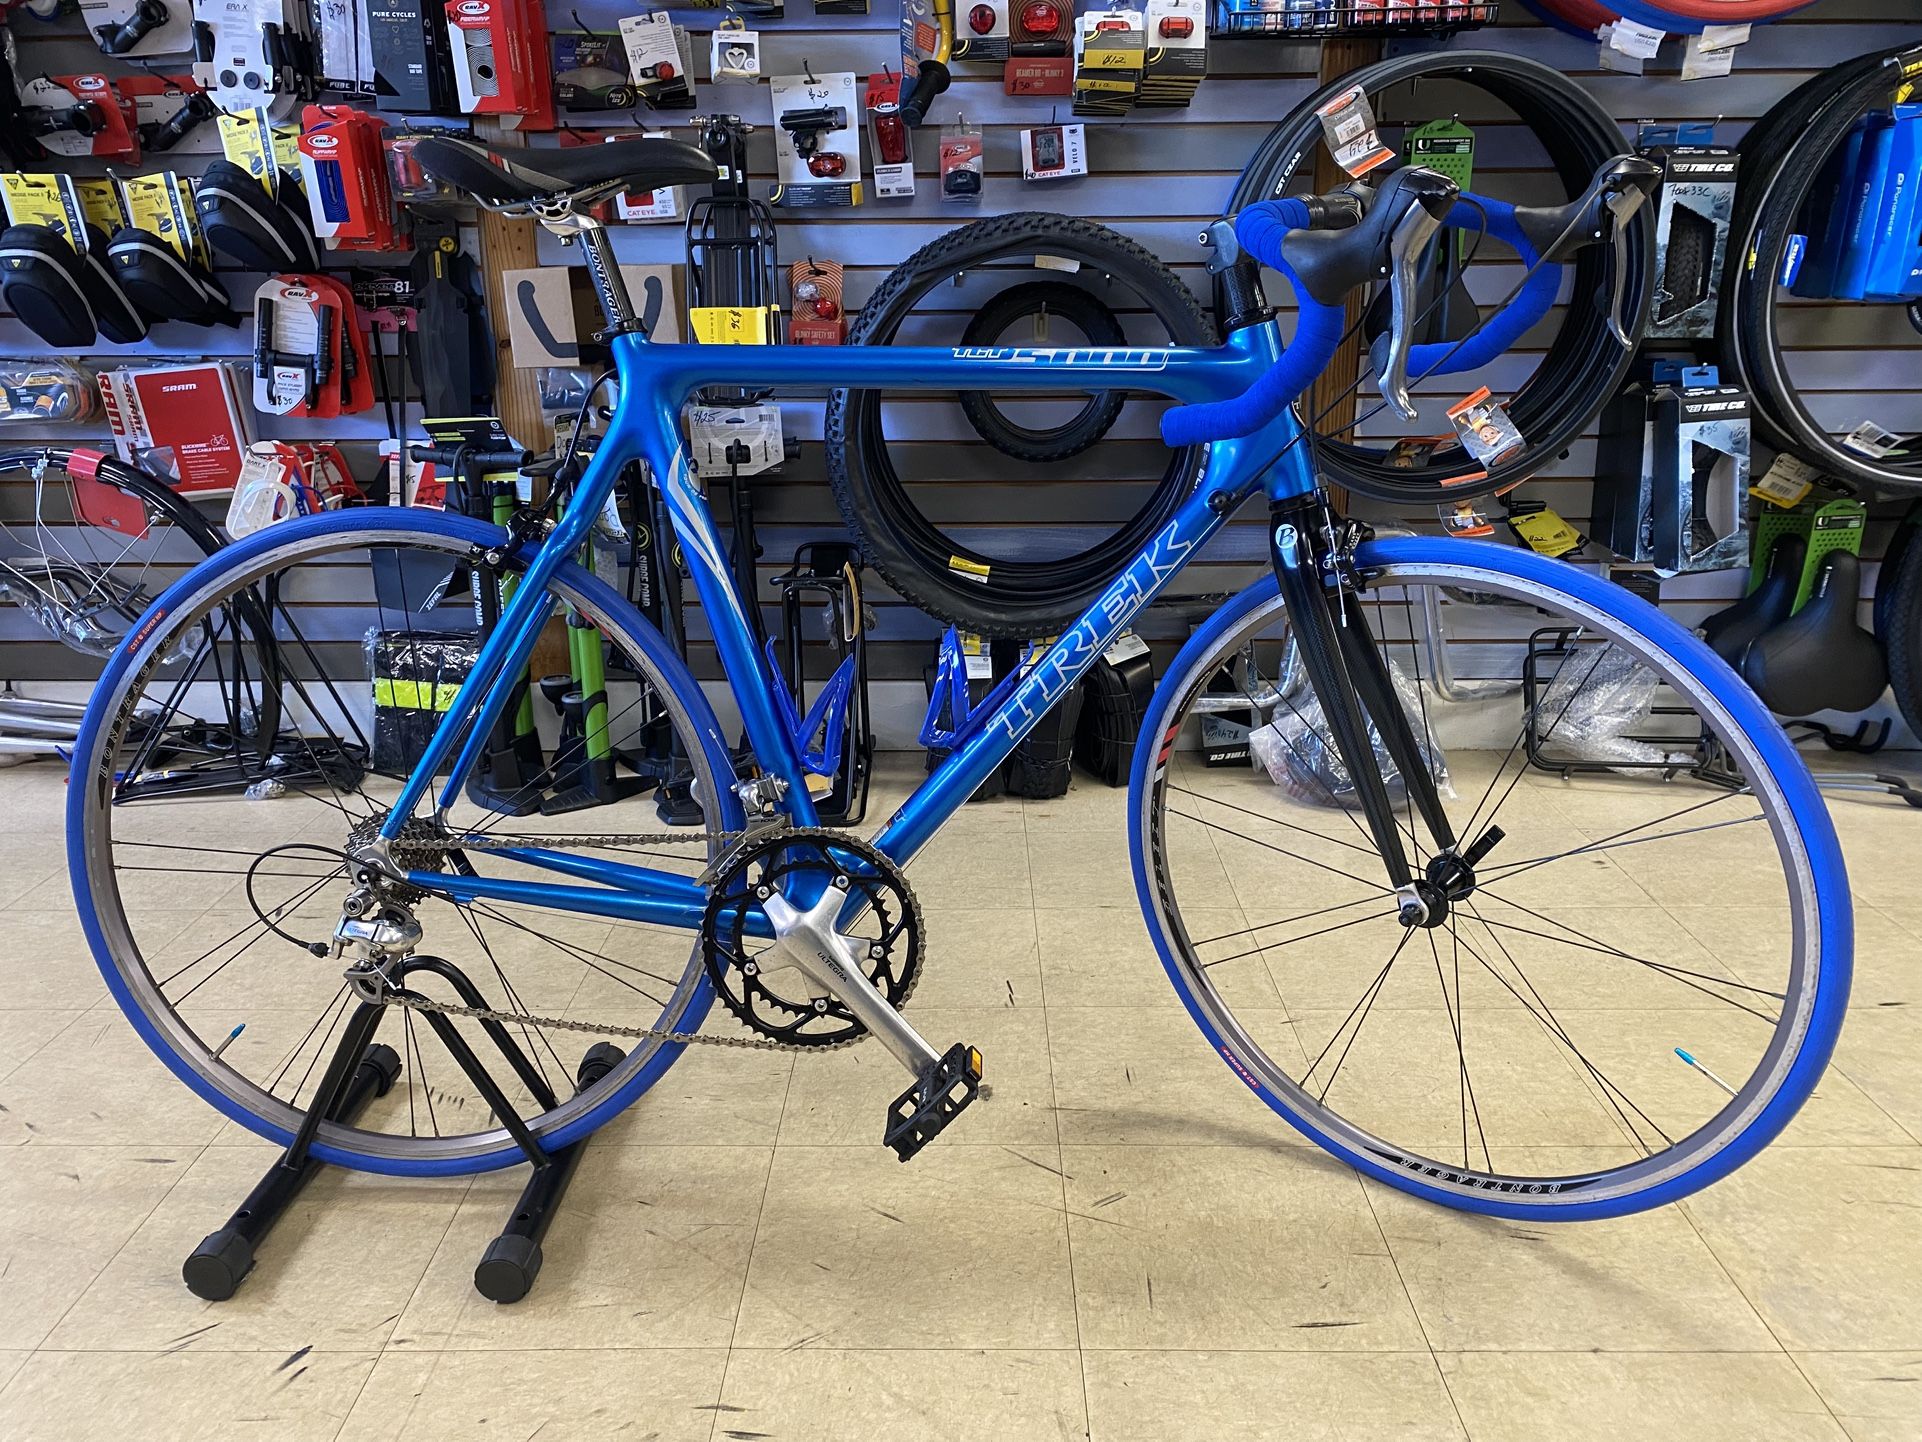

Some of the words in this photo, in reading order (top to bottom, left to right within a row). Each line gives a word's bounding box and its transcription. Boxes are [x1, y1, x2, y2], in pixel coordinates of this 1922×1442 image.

[1689, 163, 1717, 172] TIRE
[394, 280, 410, 293] 81
[588, 244, 622, 324] BONTRAGER
[162, 383, 198, 393] SRAM
[1702, 401, 1729, 412] TIRE
[985, 519, 1193, 740] TREK
[817, 951, 848, 983] ULTEGRA
[1400, 1156, 1562, 1195] BONTRAGER
